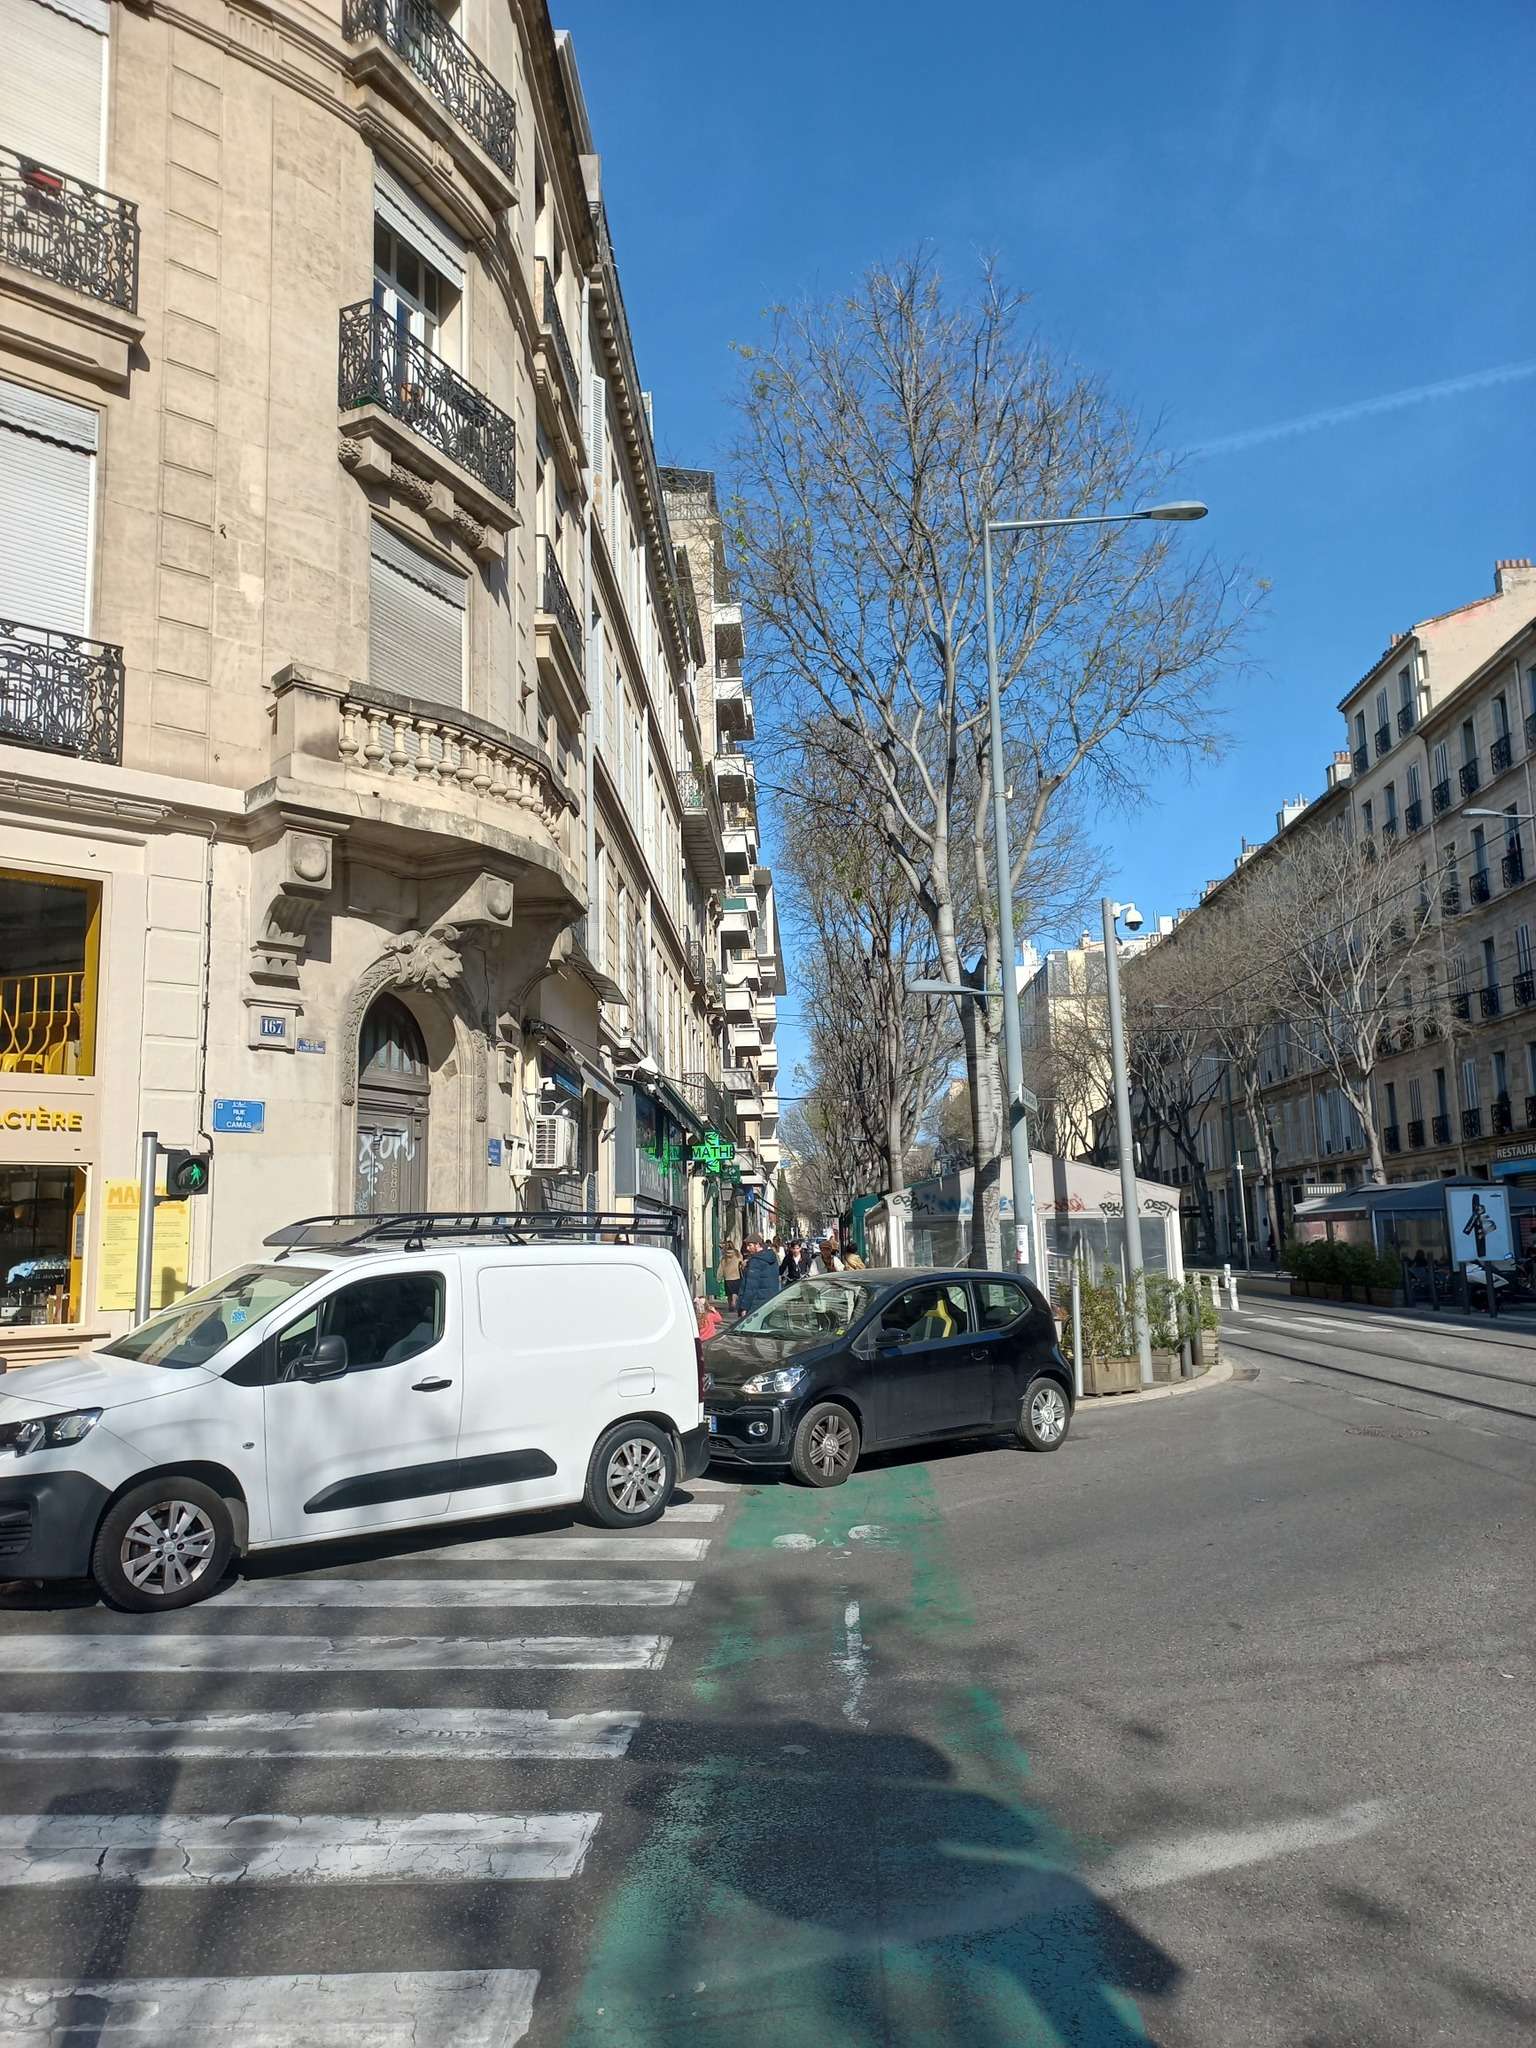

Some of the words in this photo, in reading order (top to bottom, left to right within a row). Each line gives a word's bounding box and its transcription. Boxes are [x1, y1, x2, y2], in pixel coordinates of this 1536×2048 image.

[263, 1019, 283, 1035] 167
[0, 1105, 82, 1132] CTÈRE
[226, 1121, 252, 1129] CAMAS
[1497, 1144, 1536, 1159] RESTAUR
